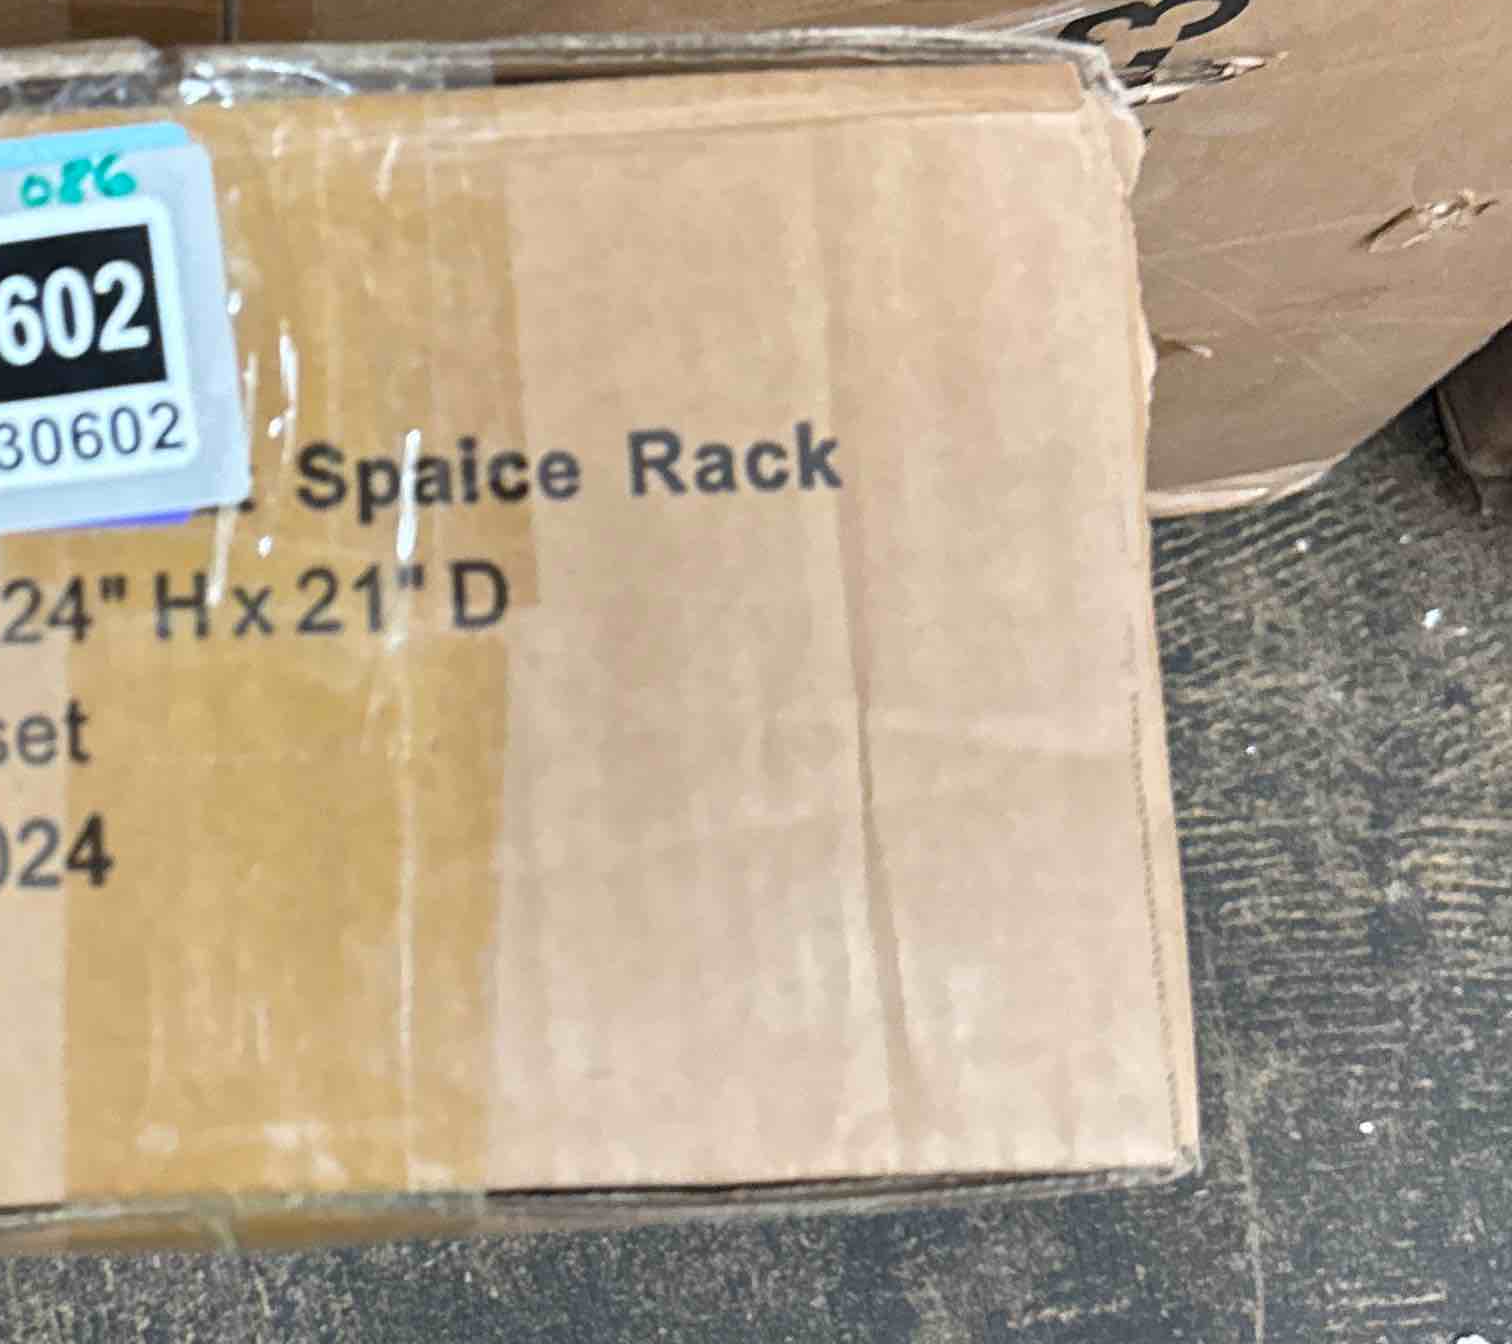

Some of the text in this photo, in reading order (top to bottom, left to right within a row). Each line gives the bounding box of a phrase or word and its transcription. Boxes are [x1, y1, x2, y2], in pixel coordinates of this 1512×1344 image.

[294, 421, 844, 524] Spaice Rack
[154, 569, 210, 641] H
[231, 586, 276, 638] x
[449, 558, 511, 630] D
